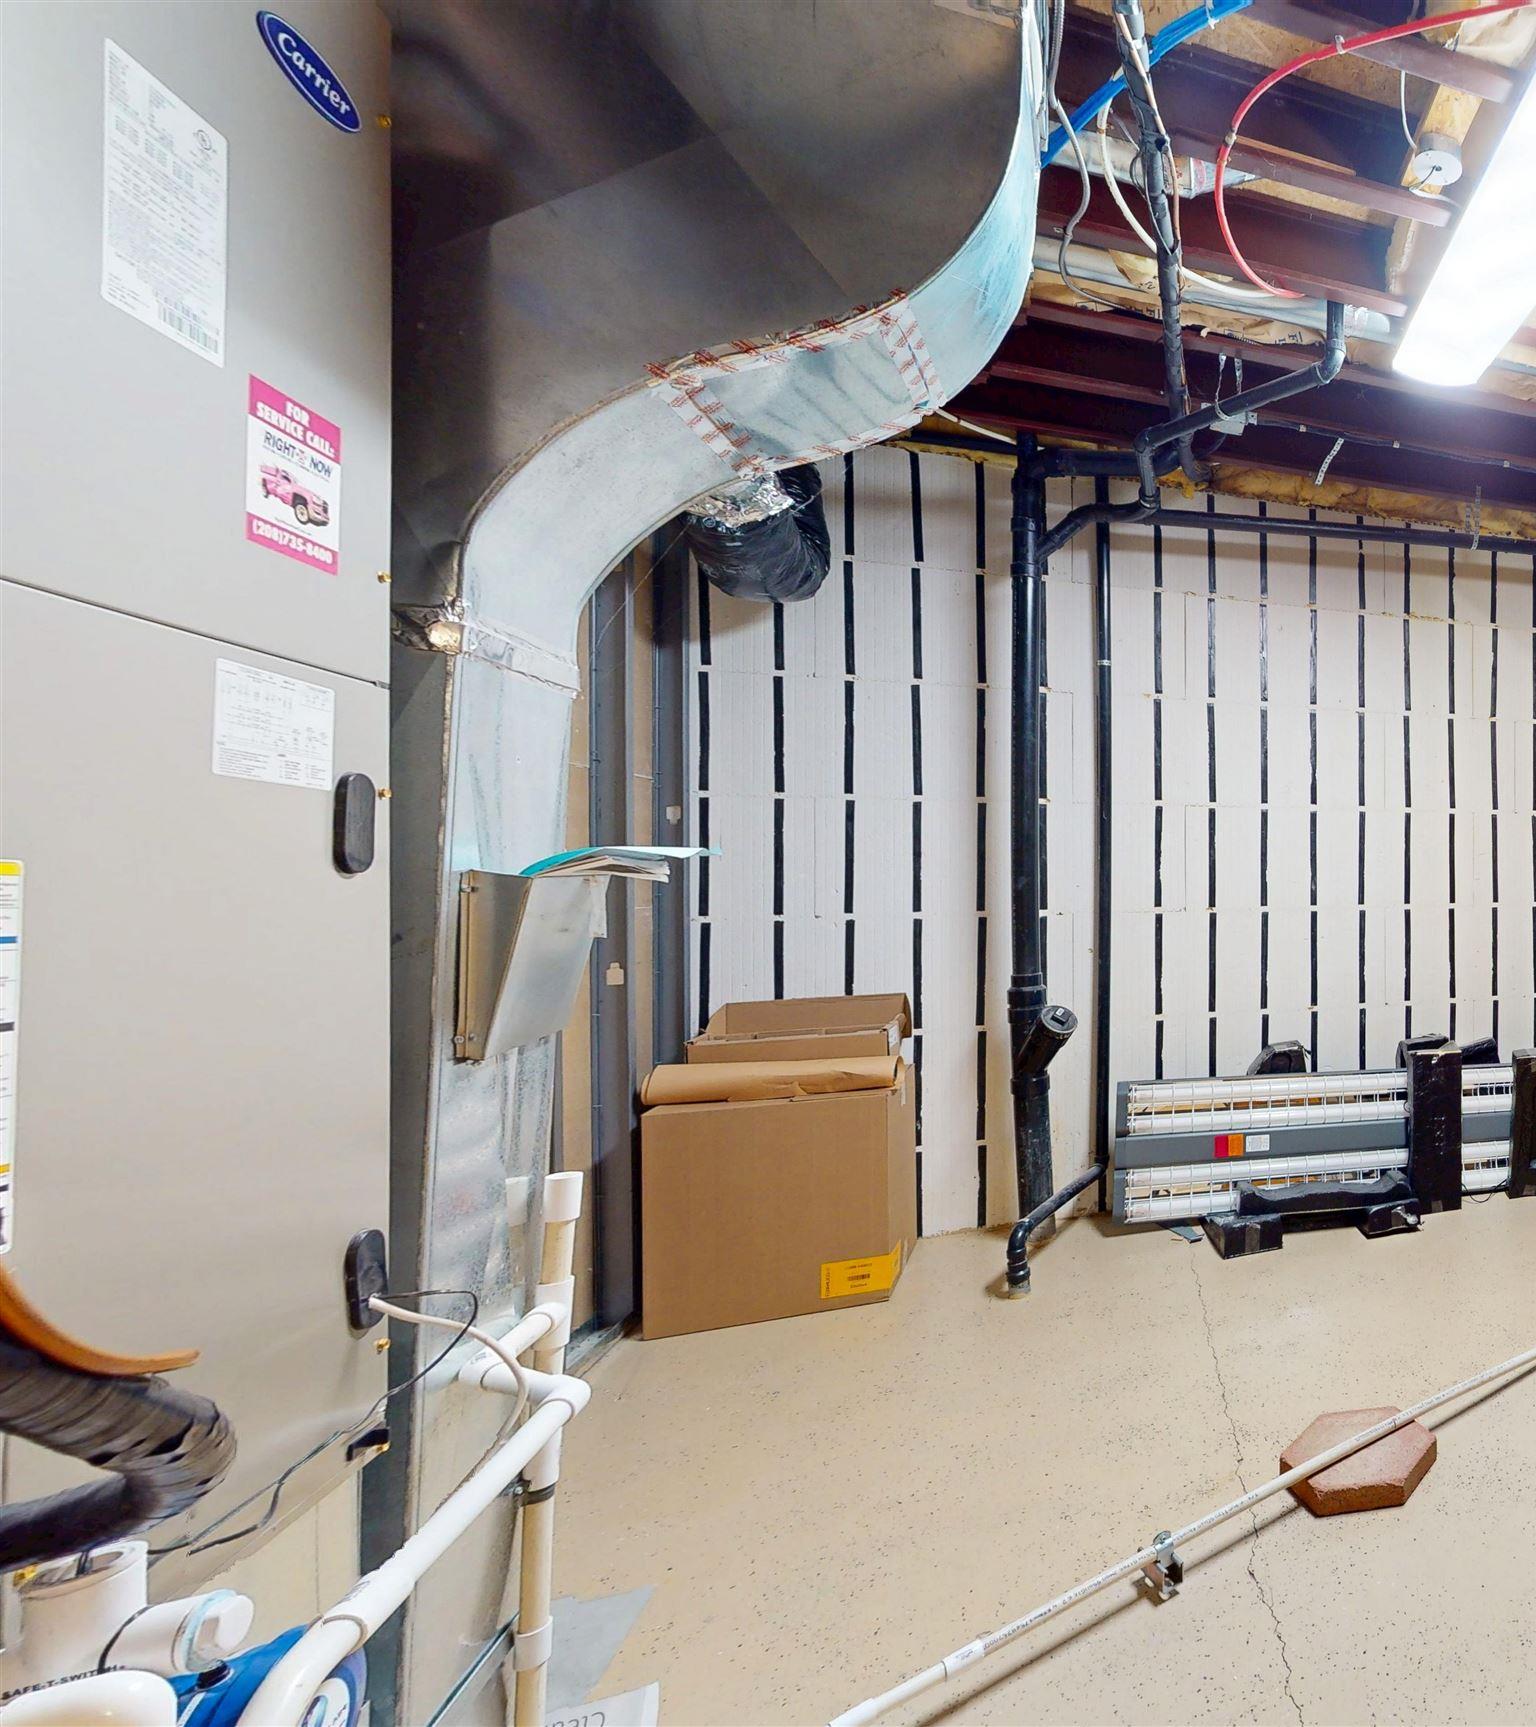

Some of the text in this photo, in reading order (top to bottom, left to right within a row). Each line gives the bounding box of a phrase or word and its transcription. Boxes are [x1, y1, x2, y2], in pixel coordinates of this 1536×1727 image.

[278, 32, 351, 114] Carrier
[256, 401, 305, 442] SERVICE
[286, 401, 310, 428] FOR
[264, 430, 332, 478] RIGHT NOW
